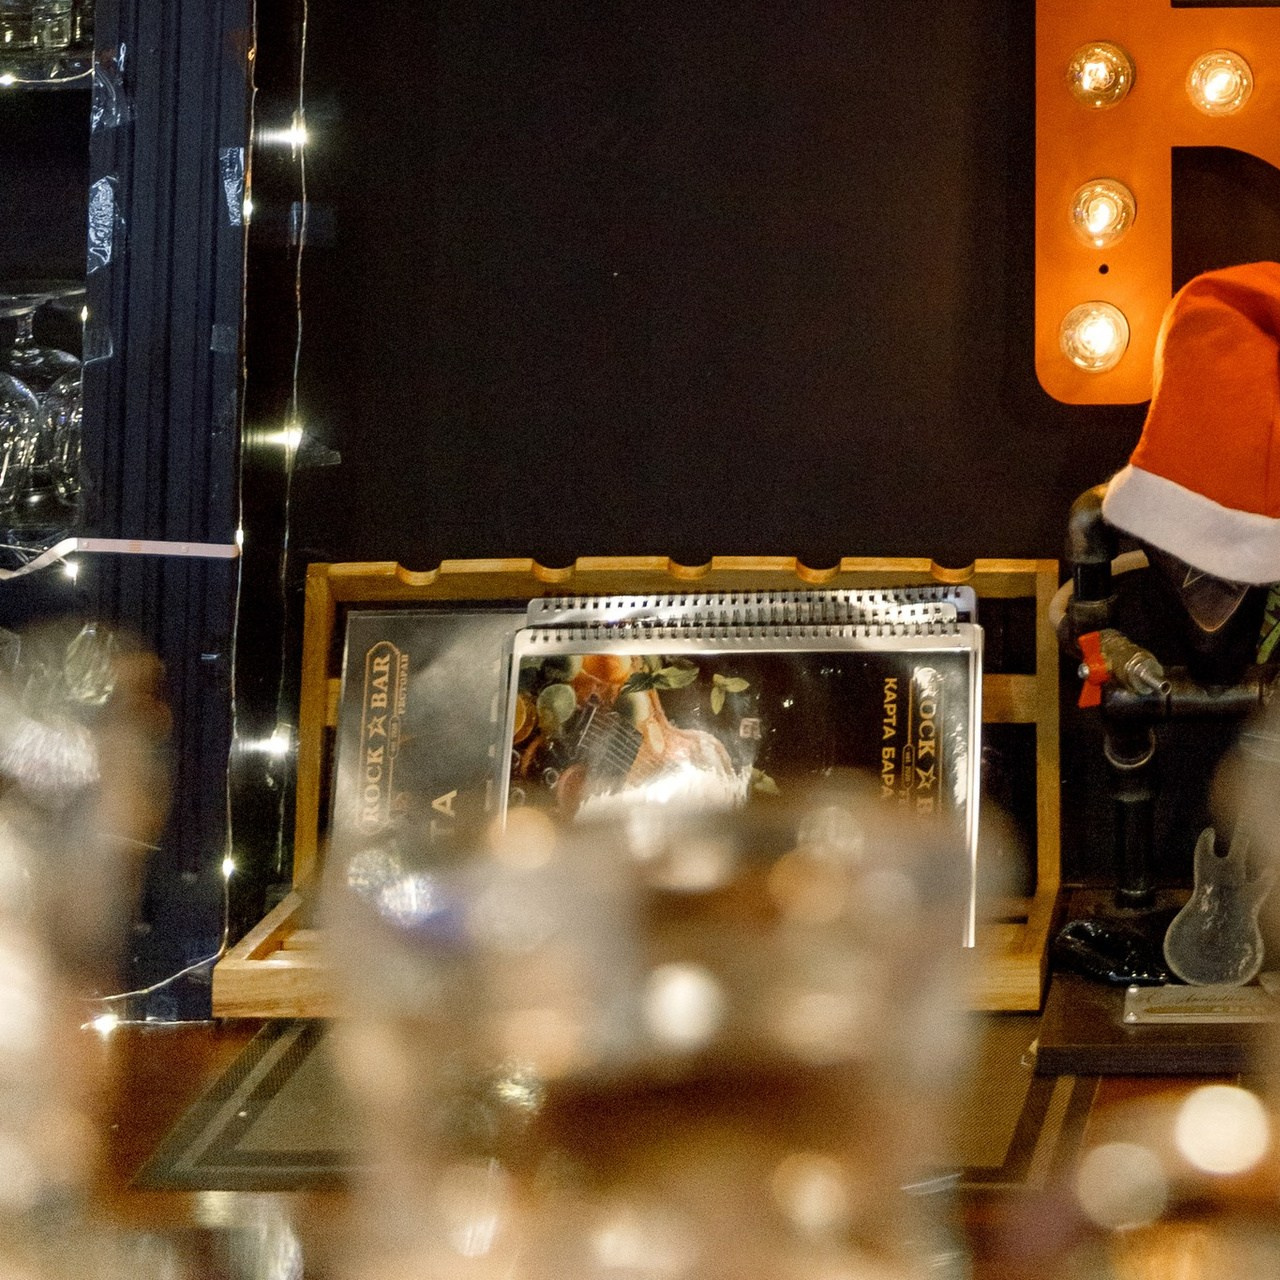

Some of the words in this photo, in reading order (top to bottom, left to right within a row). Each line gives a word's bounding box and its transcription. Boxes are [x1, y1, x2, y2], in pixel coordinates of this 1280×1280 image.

[371, 654, 390, 709] BAR
[882, 677, 898, 740] КАРТА
[363, 744, 385, 824] ROCK
